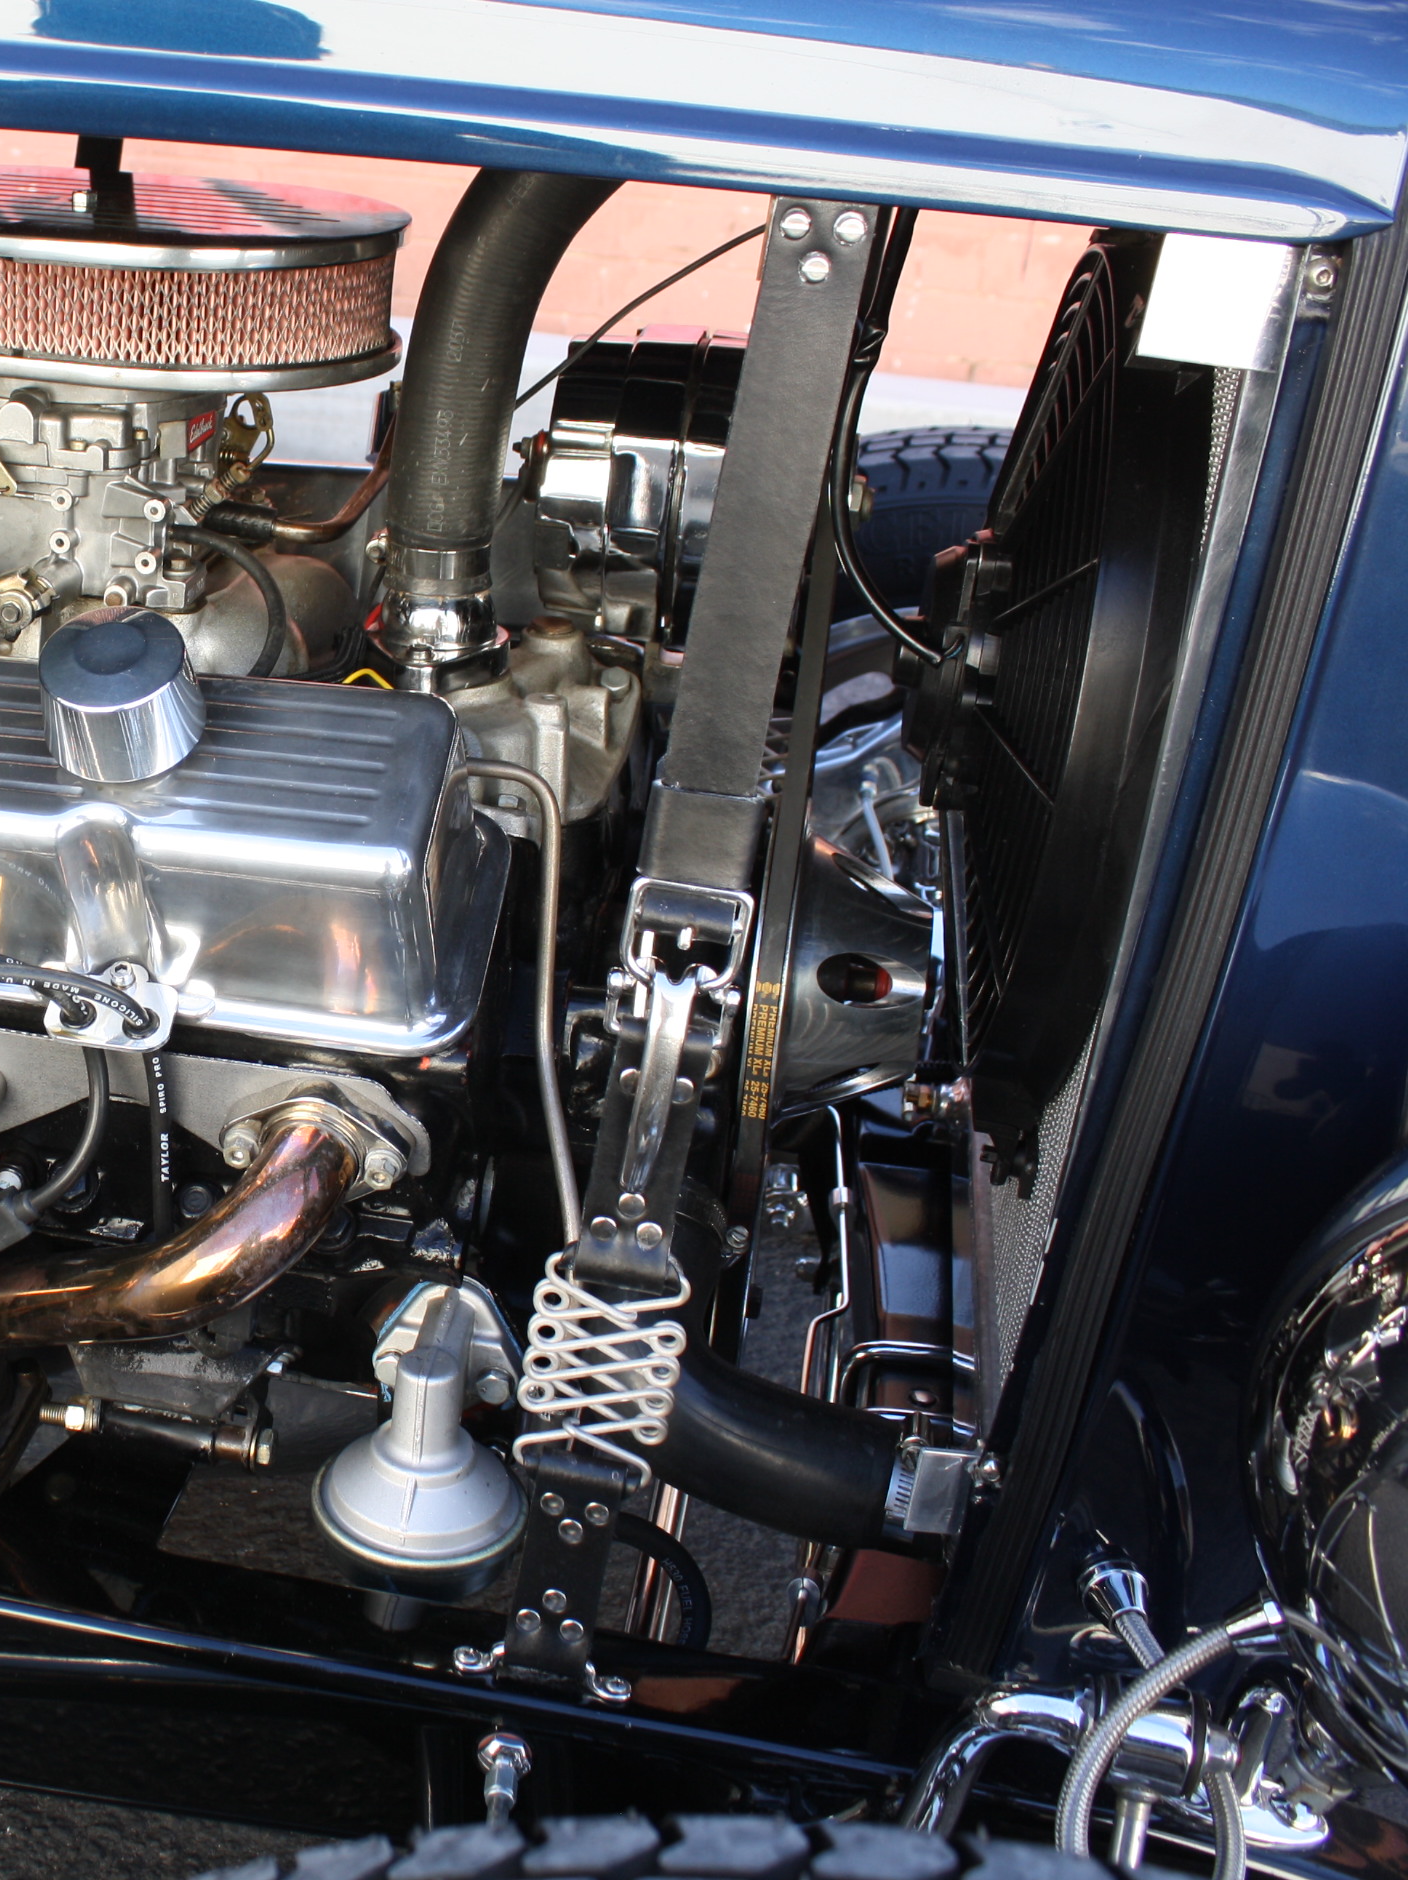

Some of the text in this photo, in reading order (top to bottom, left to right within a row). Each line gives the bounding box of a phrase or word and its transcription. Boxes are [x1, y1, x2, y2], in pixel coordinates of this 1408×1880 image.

[22, 978, 35, 987] IN
[43, 981, 80, 994] MADE
[93, 992, 144, 1027] SILICONE
[754, 1004, 770, 1057] PREMIUM
[748, 1080, 760, 1118] 25-7460
[152, 1056, 170, 1182] TAYLOR SPIRO PRO
